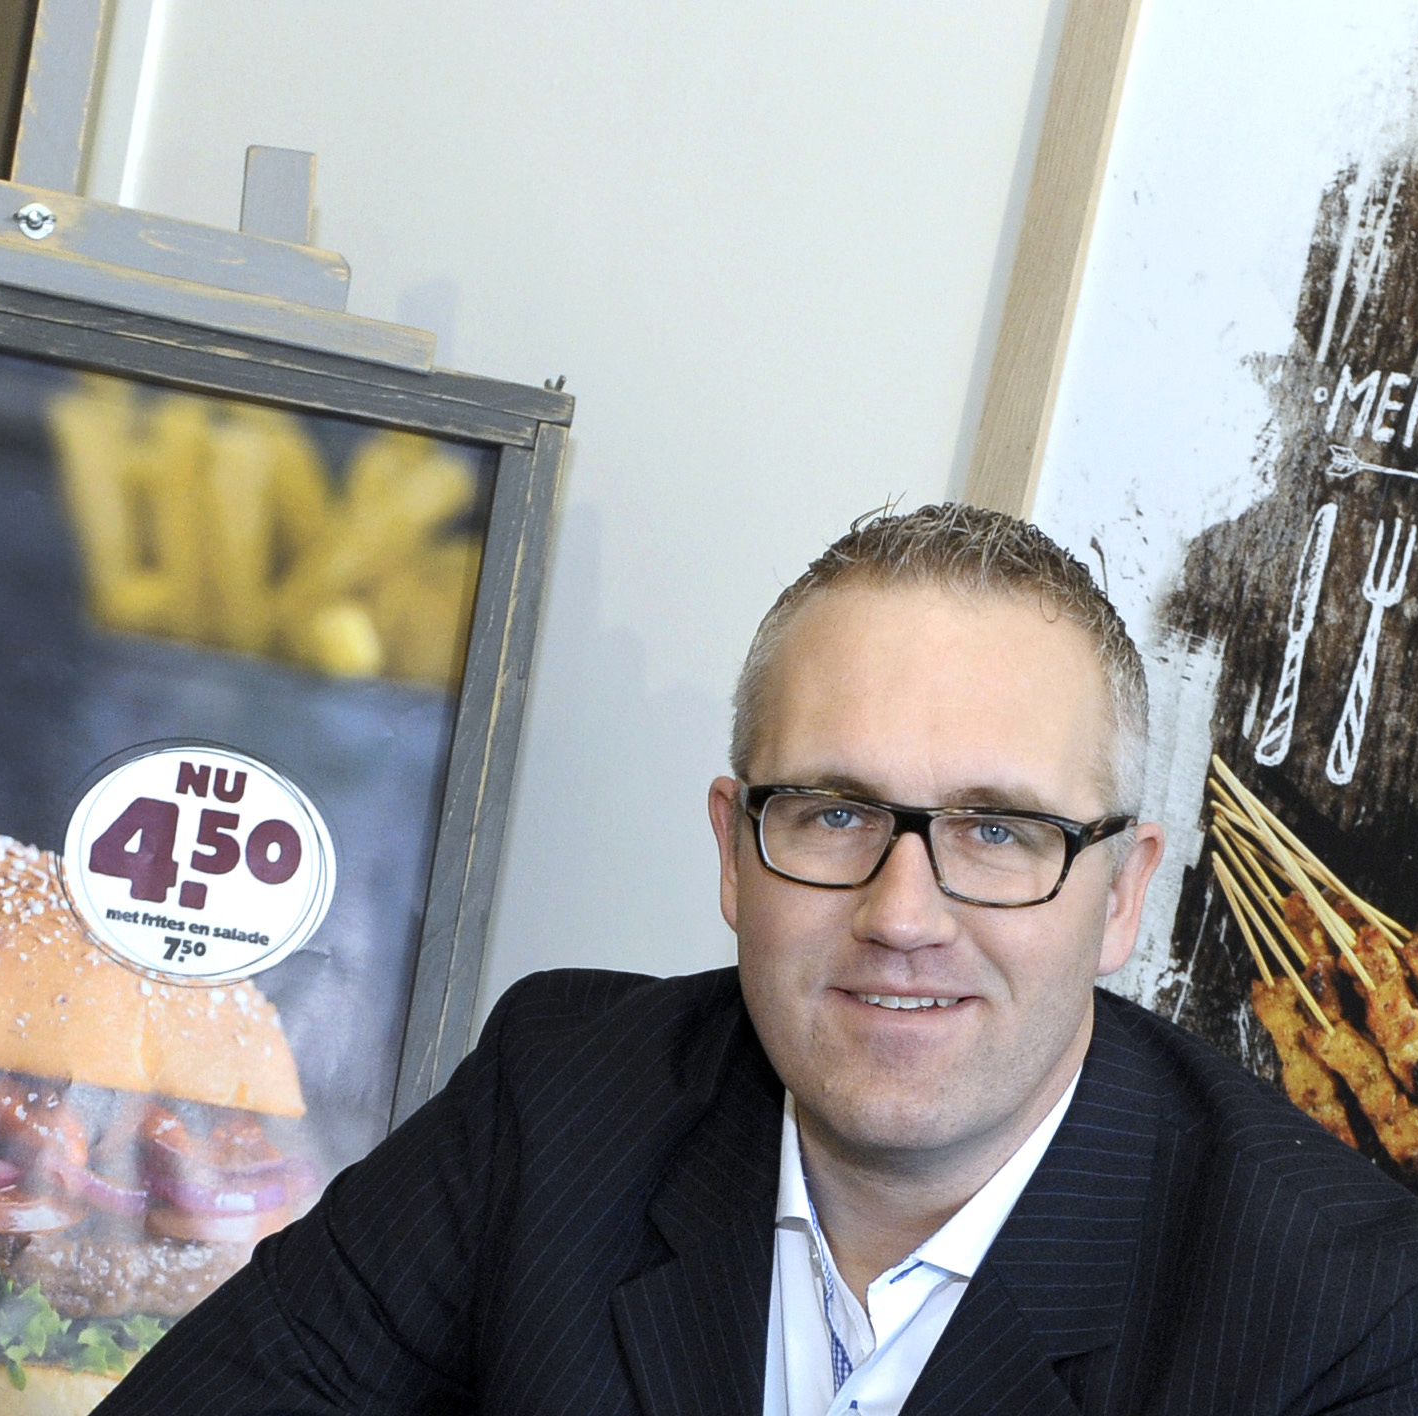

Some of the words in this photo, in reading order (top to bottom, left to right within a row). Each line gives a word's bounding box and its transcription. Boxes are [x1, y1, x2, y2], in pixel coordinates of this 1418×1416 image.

[176, 761, 247, 804] NU
[106, 909, 138, 924] met
[142, 913, 185, 931] frites
[189, 923, 209, 936] en
[213, 927, 269, 946] salade
